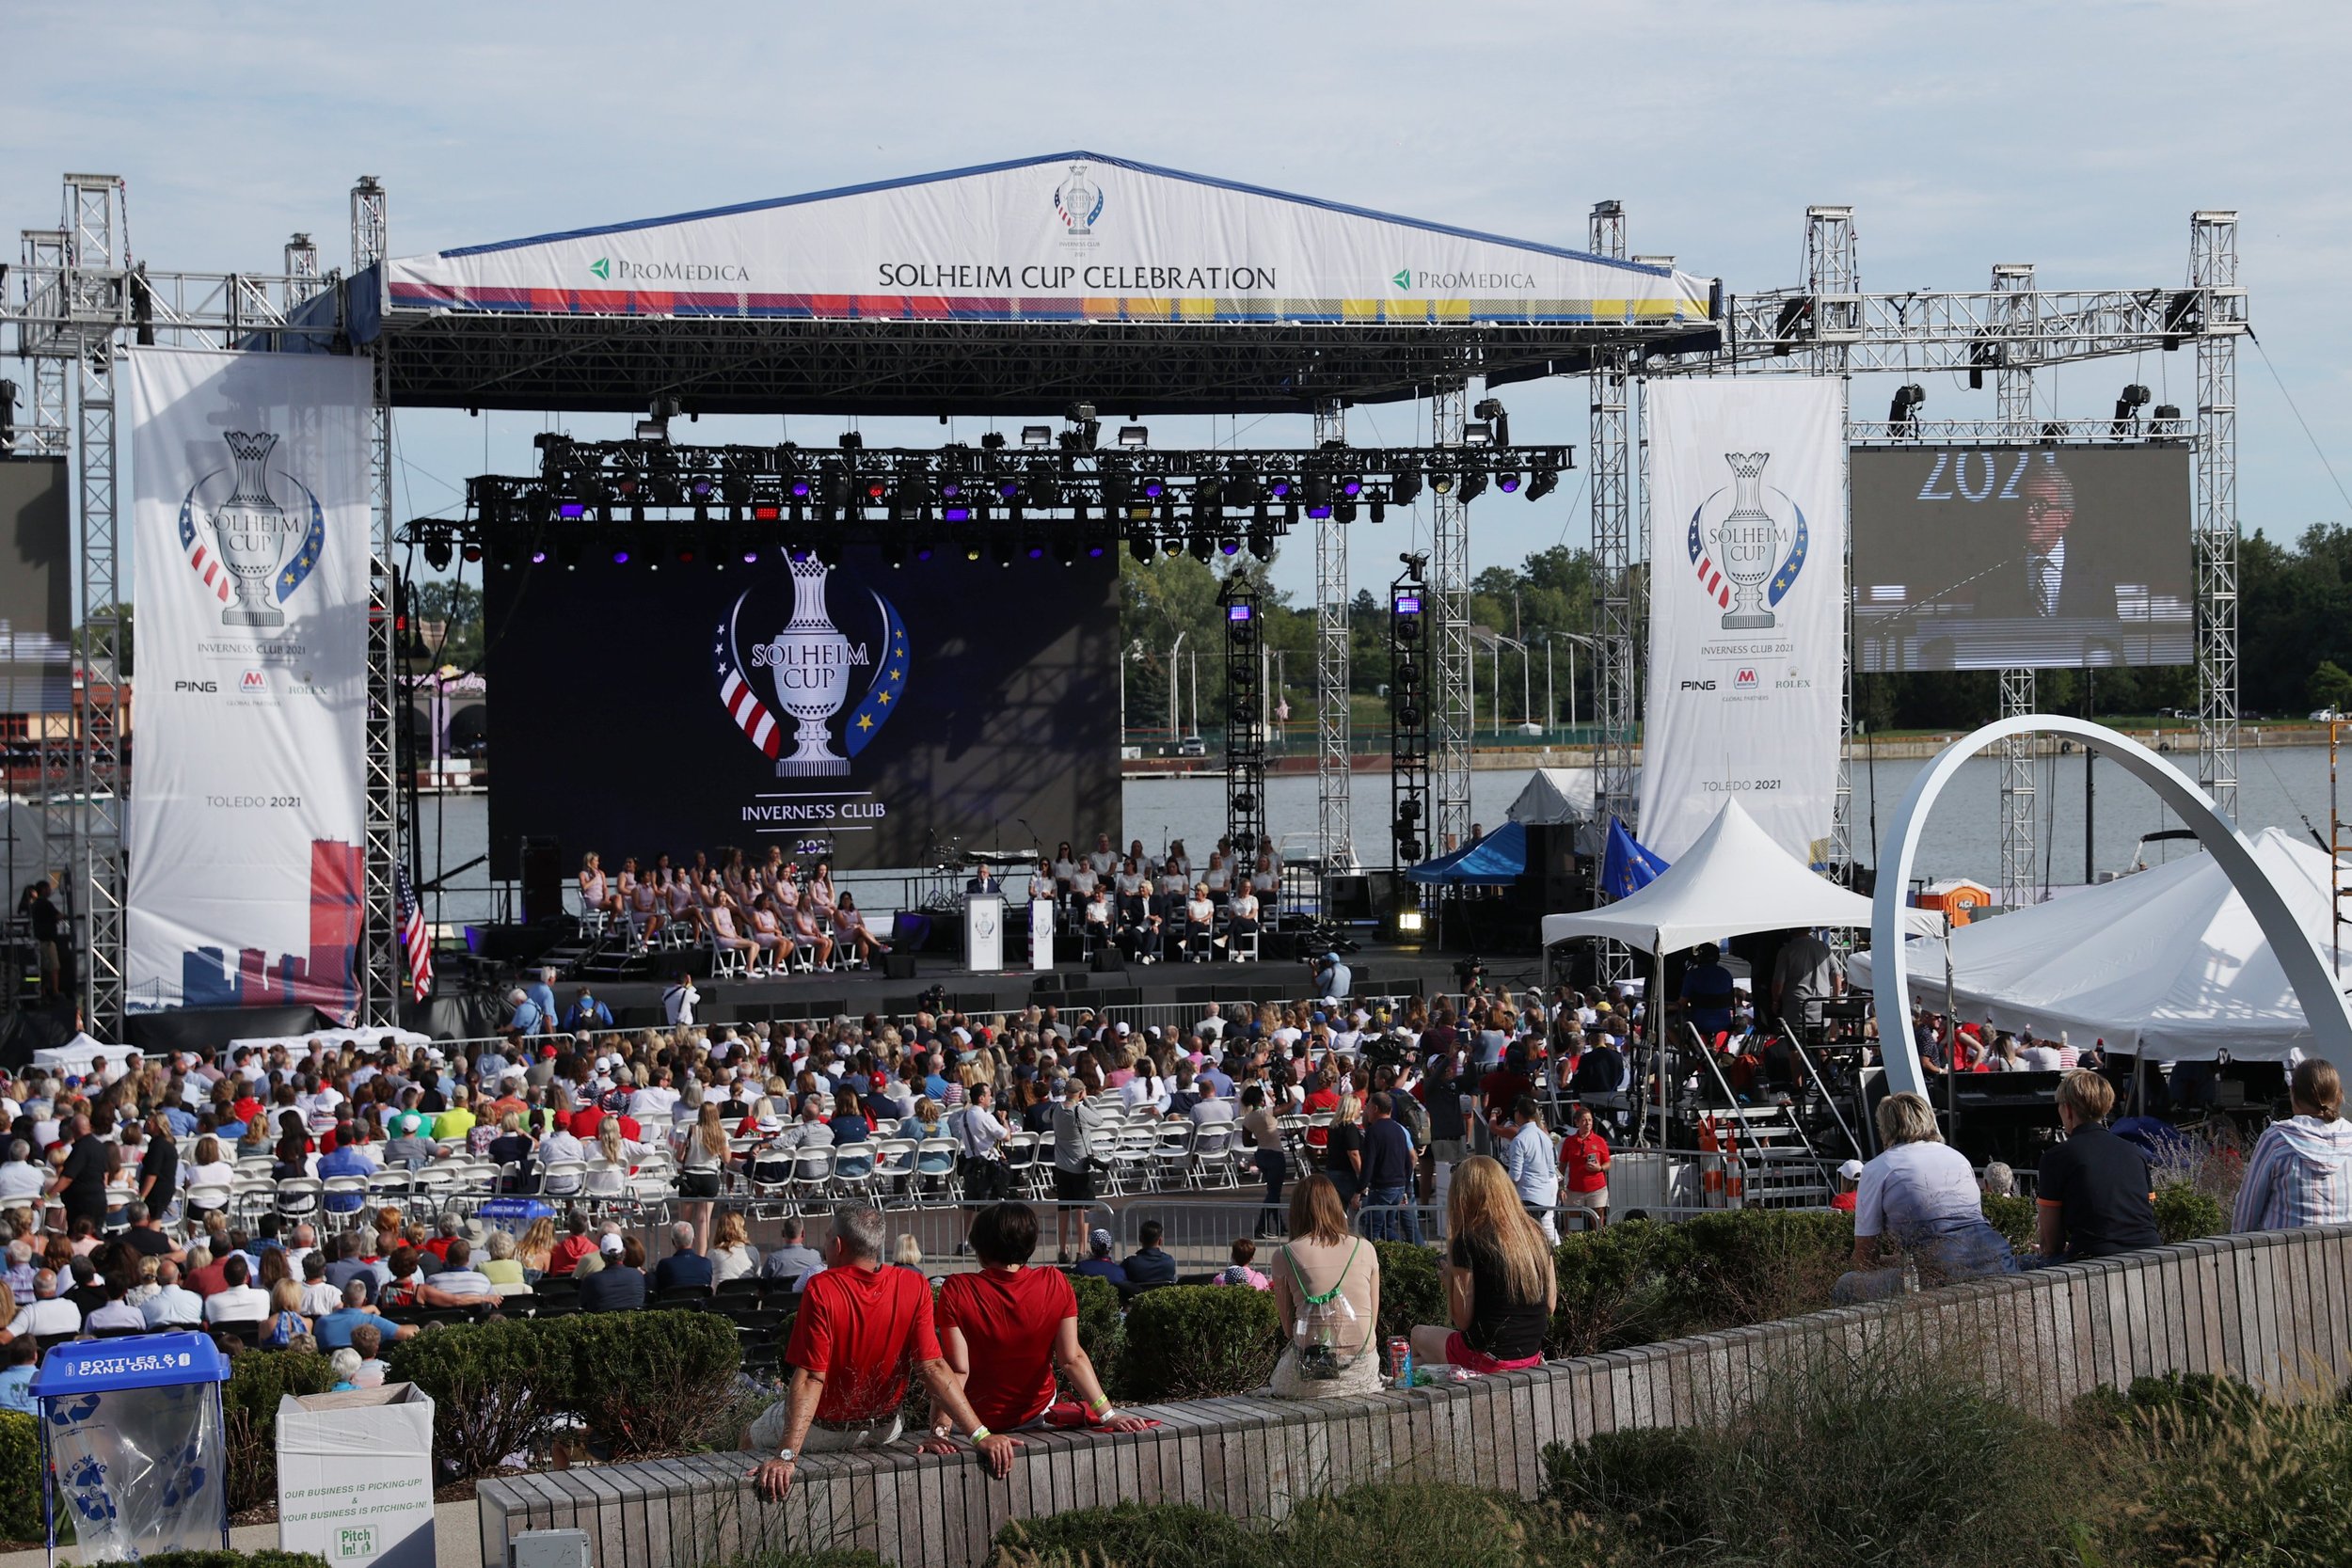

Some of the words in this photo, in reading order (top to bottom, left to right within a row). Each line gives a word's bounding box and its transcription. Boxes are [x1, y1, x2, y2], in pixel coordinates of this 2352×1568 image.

[879, 263, 1009, 288] SOLHEIM
[1021, 265, 1075, 289] CUP
[1084, 266, 1276, 290] CELEBRATION
[1916, 451, 2055, 502] 202
[203, 514, 300, 533] SOLHEIM
[229, 534, 271, 552] CUP
[1709, 528, 1788, 545] SOLHEIM
[1730, 546, 1766, 562] CUP
[198, 643, 254, 654] INVERNESS
[256, 644, 283, 655] CLUB
[286, 646, 307, 656] 2021
[752, 642, 869, 666] SOLHEIM
[1701, 645, 1748, 655] INVERNESS
[1750, 644, 1773, 653] CLUB
[1774, 643, 1794, 652] 2021
[784, 668, 835, 689] CUP
[1680, 680, 1716, 691] PING
[1775, 680, 1811, 689] ROLEX
[175, 681, 217, 693] PING
[289, 686, 327, 694] ROLEX
[1702, 781, 1751, 791] TOLEDO
[1755, 780, 1781, 790] 2021
[206, 797, 265, 807] TOLEDO
[270, 796, 301, 807] 2021
[742, 804, 836, 821] INVERNESS
[841, 802, 886, 818] CLUB
[78, 1366, 125, 1376] CANS
[131, 1360, 177, 1371] ONLY
[80, 1355, 157, 1369] BOTTLES
[284, 1490, 305, 1499] OUR
[307, 1485, 354, 1497] BUSINESS
[357, 1483, 365, 1492] IS
[368, 1479, 422, 1490] PICKING-UP!
[283, 1513, 308, 1522] YOUR
[310, 1508, 357, 1520] BUSINESS
[358, 1507, 368, 1515] IS
[370, 1501, 427, 1513] PITCHING-IN!
[342, 1528, 371, 1543] Pitch
[342, 1542, 356, 1556] In!
